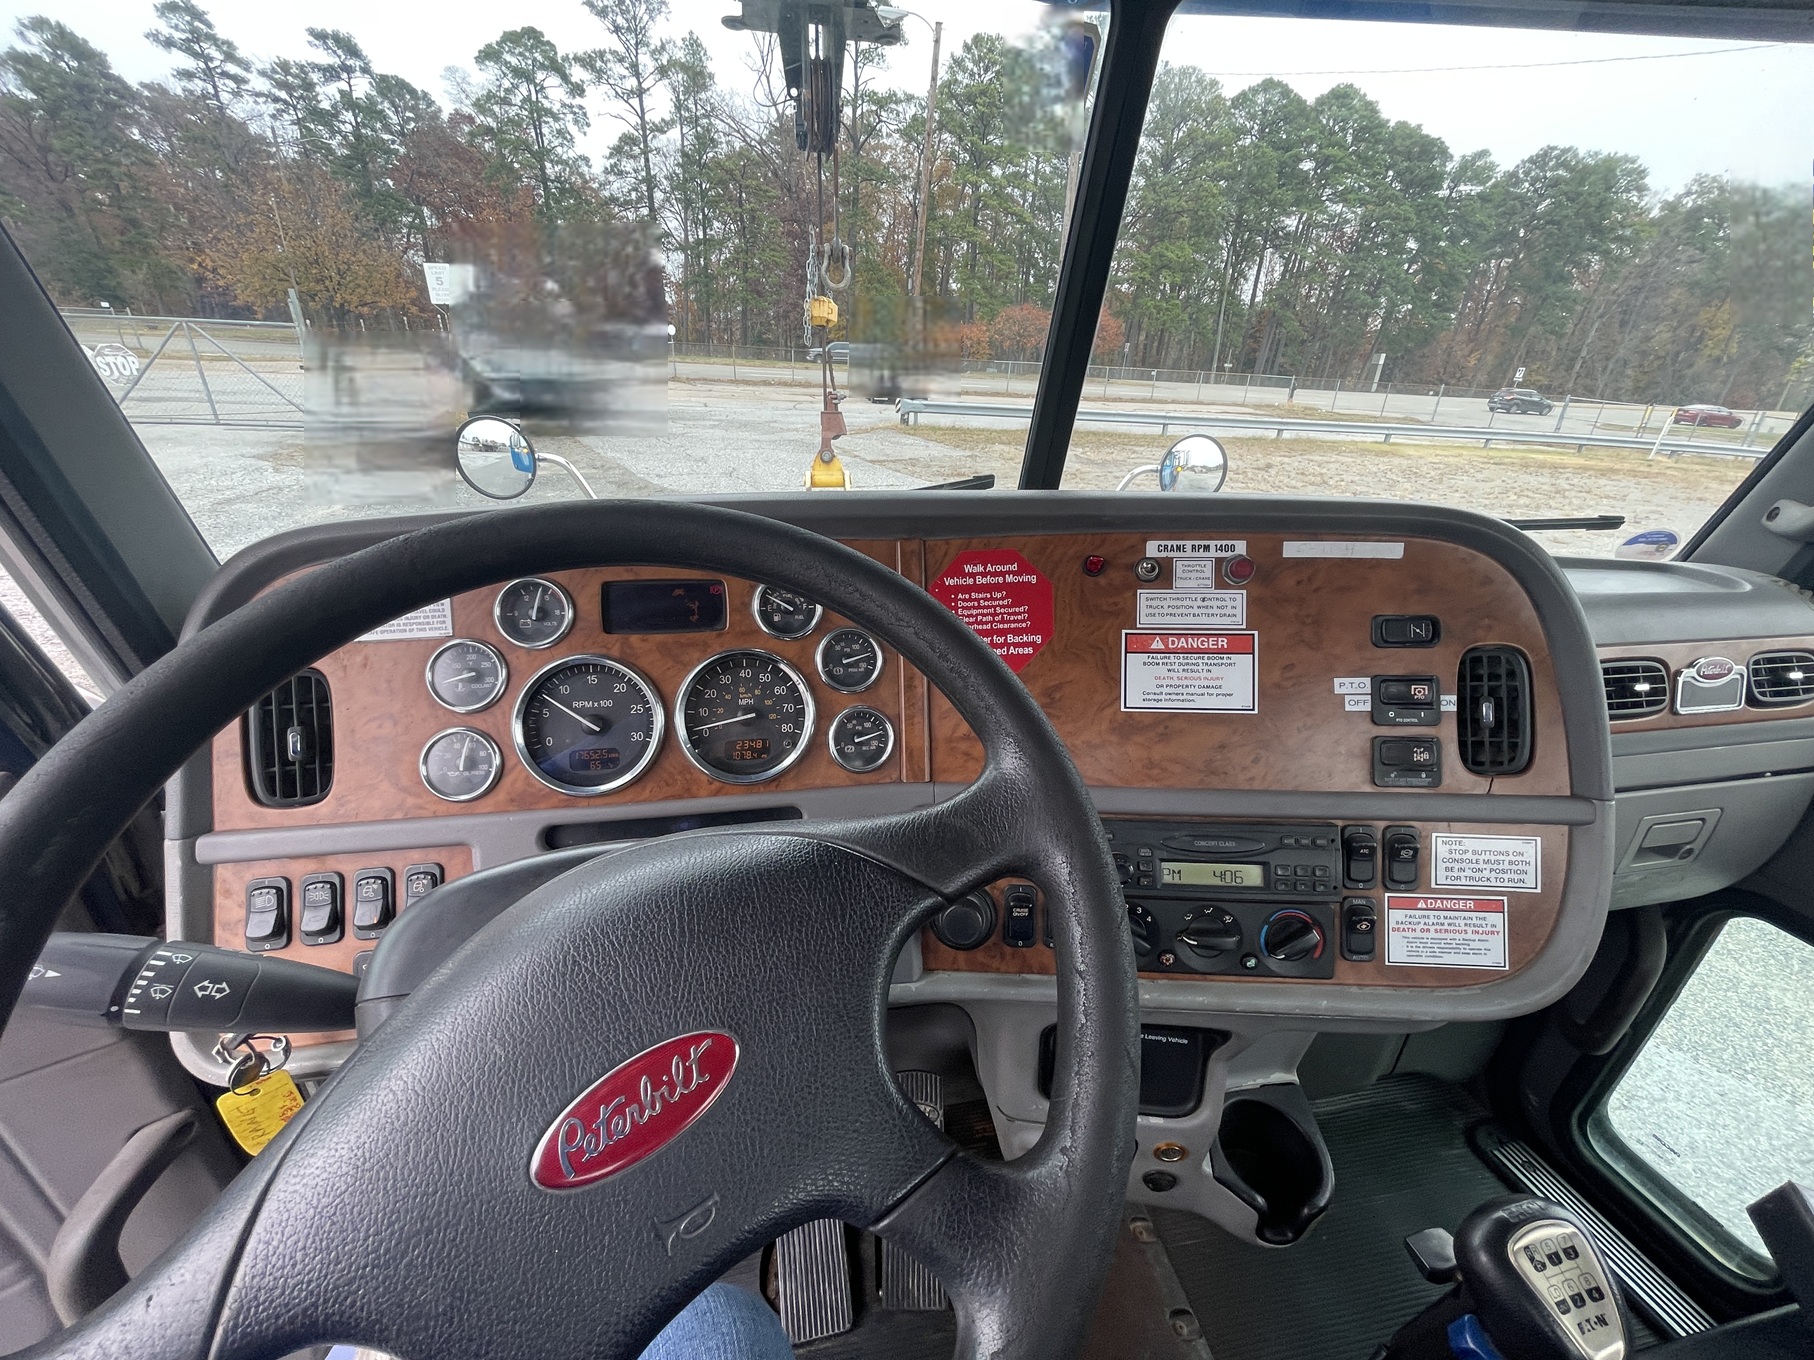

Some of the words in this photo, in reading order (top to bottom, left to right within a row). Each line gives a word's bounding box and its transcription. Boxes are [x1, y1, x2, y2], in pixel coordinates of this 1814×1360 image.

[436, 277, 443, 286] 5
[96, 356, 139, 379] STOP
[1158, 544, 1187, 553] CRANE
[1191, 544, 1210, 552] RPM
[1215, 544, 1235, 552] 1400
[964, 564, 984, 573] Walk
[986, 563, 1017, 572] Around
[944, 577, 974, 585] Vehicle
[976, 576, 1003, 584] Before
[1006, 574, 1036, 583] Moving
[993, 635, 1005, 643] for
[1007, 634, 1041, 643] Backing
[1168, 637, 1228, 648] DANGER
[1009, 646, 1033, 654] Areas
[740, 669, 751, 678] 40
[1701, 664, 1731, 675] Peterbilt
[586, 675, 597, 684] 15
[720, 675, 731, 684] 30
[759, 674, 771, 682] 50
[559, 685, 570, 694] 10
[614, 684, 626, 692] 20
[774, 686, 786, 694] 60
[705, 690, 716, 698] 20
[630, 705, 643, 713] 25
[699, 708, 708, 716] 10
[783, 704, 794, 712] 70
[543, 709, 549, 718] 5
[781, 724, 793, 732] 80
[631, 732, 643, 741] 30
[703, 729, 709, 737] 0
[546, 737, 553, 746] 0
[736, 740, 769, 749] 23481
[1162, 868, 1181, 881] PM
[1428, 900, 1474, 909] DANGER
[1145, 1034, 1166, 1042] Leaving
[558, 1038, 713, 1179] Peterbilt
[1567, 1249, 1575, 1257] 3
[1584, 1277, 1591, 1286] 8
[1567, 1283, 1574, 1291] 6
[1574, 1296, 1580, 1306] 2
